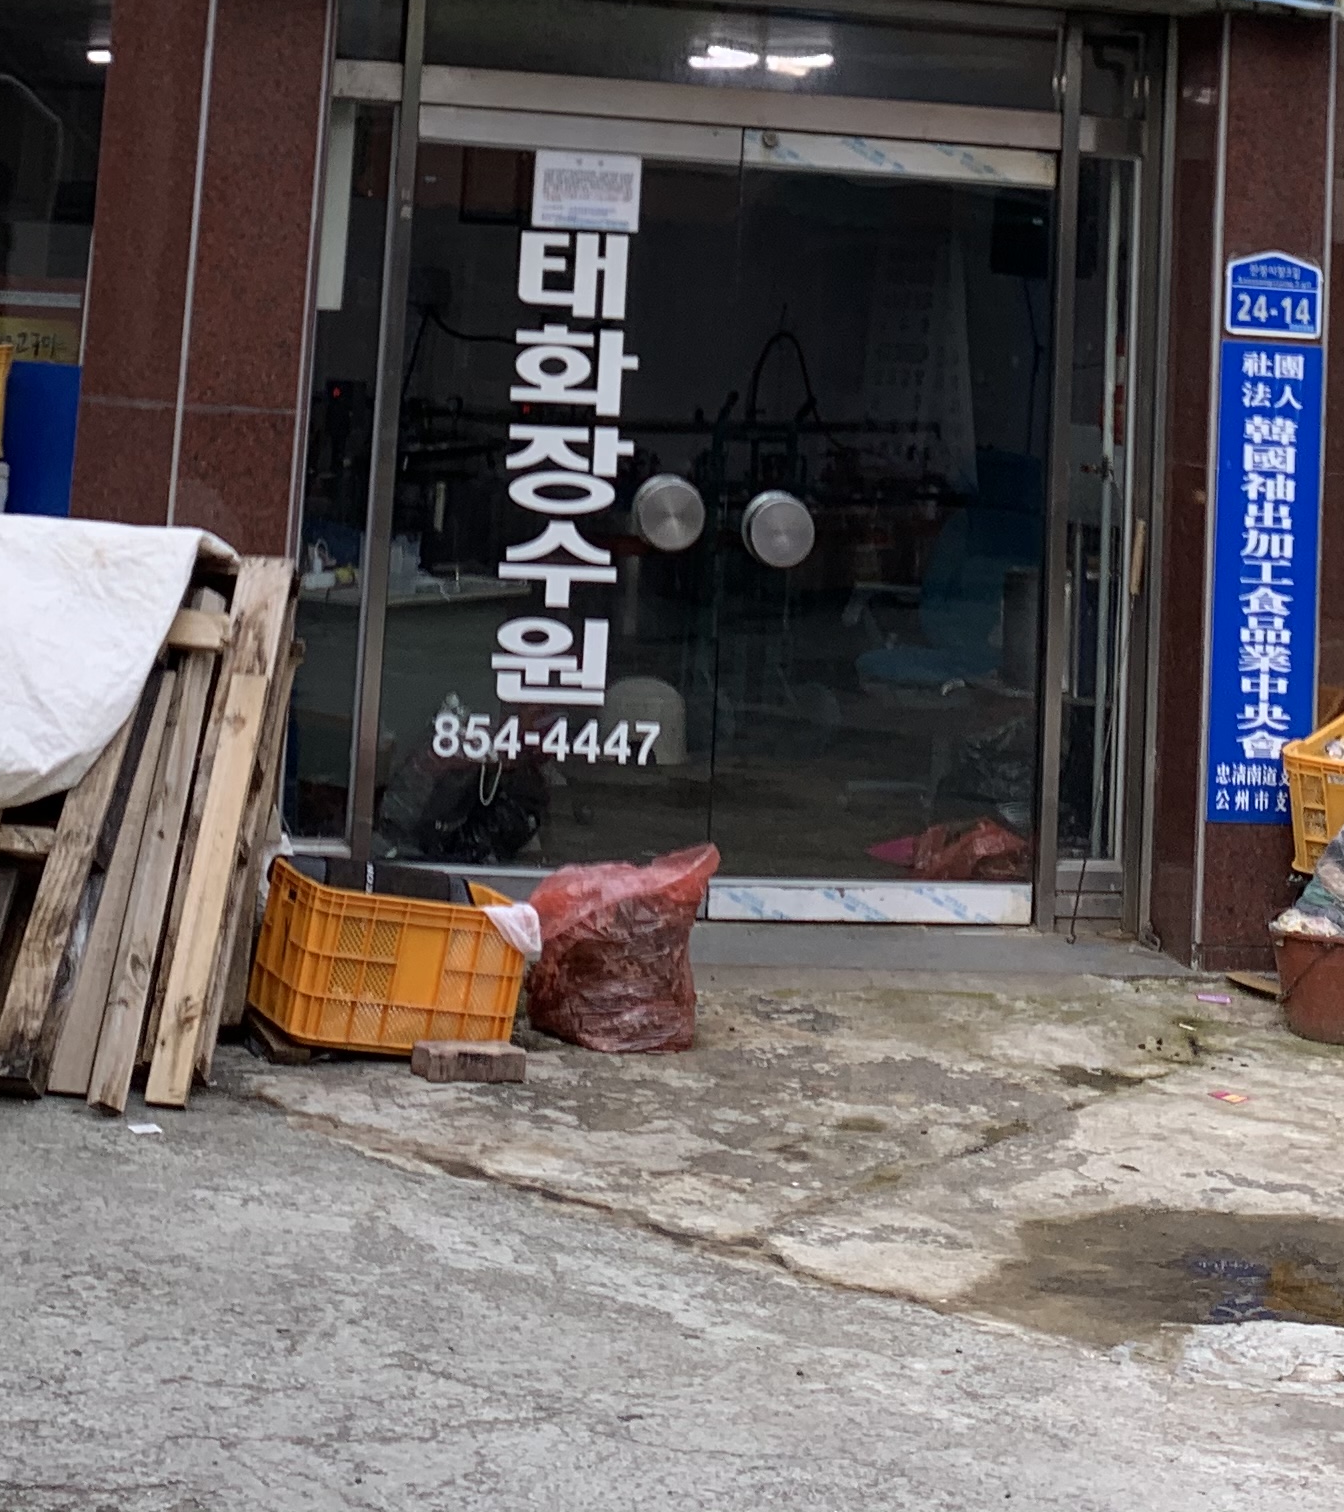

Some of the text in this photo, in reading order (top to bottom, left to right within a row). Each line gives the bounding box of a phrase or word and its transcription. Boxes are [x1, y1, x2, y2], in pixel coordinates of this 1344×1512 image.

[1237, 291, 1311, 325] 24-14
[492, 231, 639, 707] 태화장수원
[432, 715, 662, 766] 854-4447
